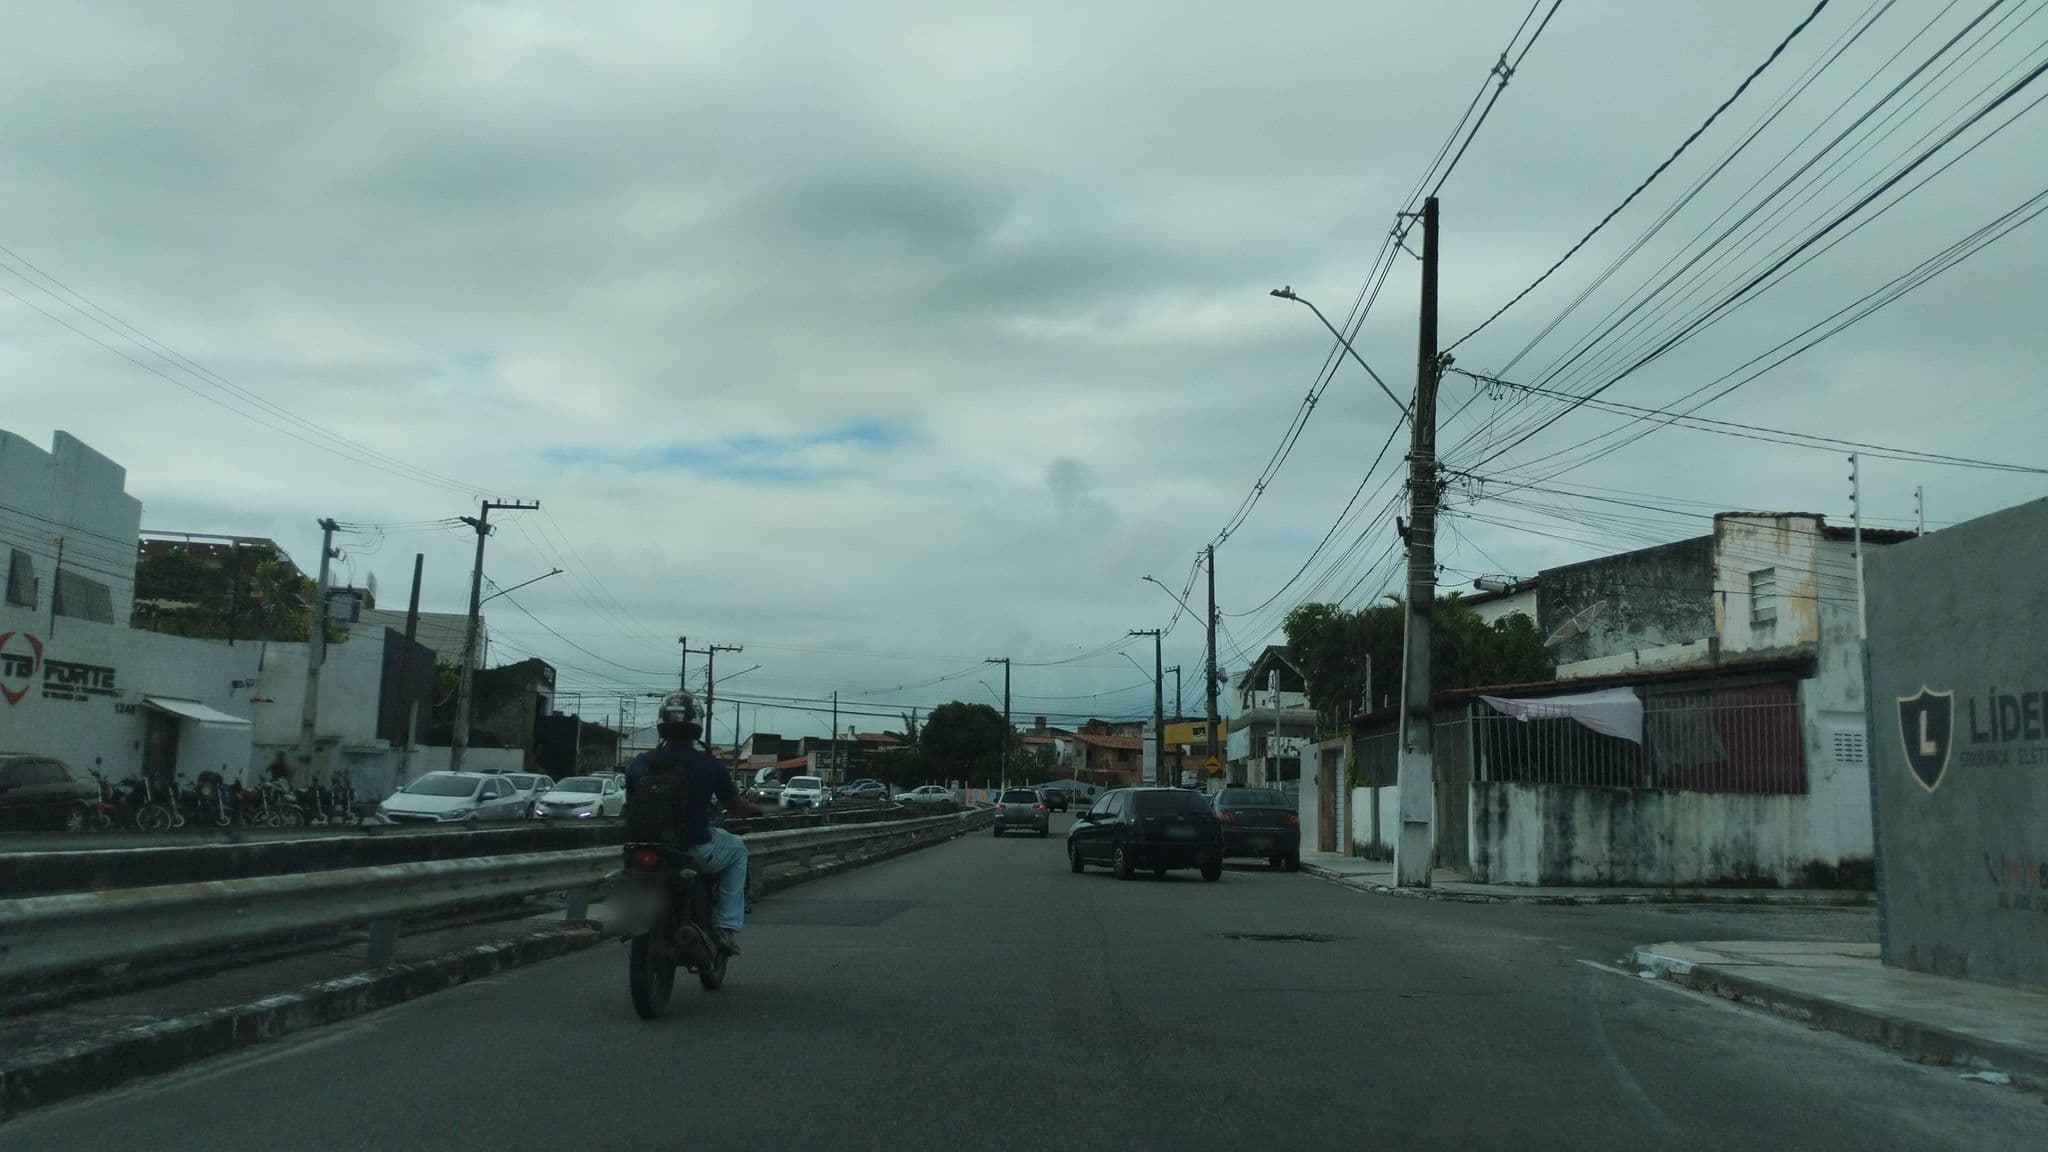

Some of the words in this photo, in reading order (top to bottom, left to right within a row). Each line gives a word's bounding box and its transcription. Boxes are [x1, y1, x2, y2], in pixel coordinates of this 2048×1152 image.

[1, 653, 33, 677] TB
[44, 658, 115, 688] FORTE
[1919, 710, 1937, 756] L
